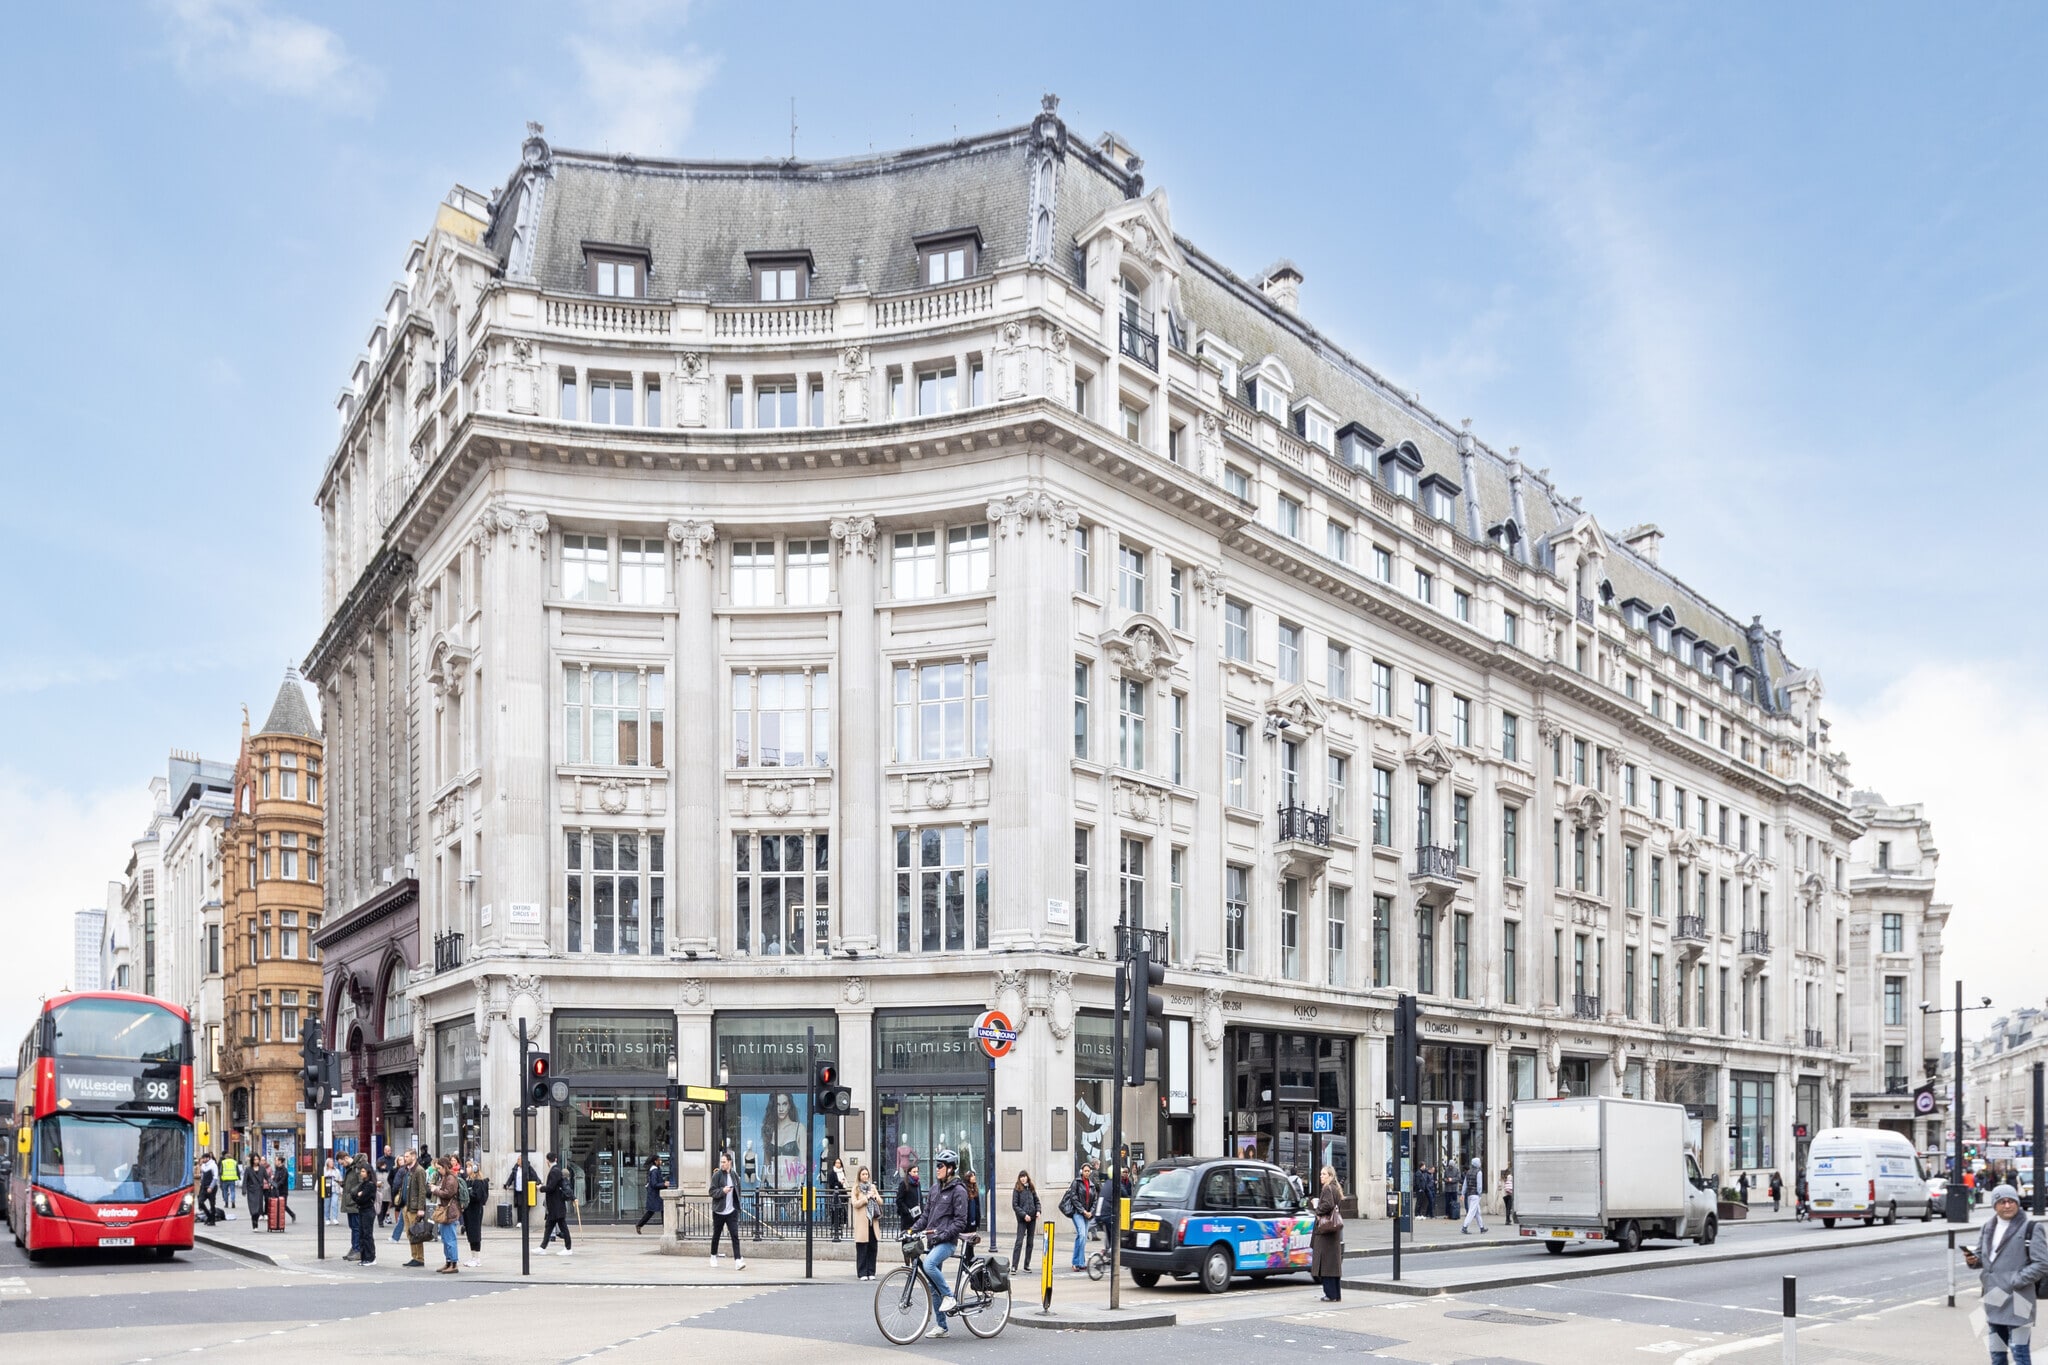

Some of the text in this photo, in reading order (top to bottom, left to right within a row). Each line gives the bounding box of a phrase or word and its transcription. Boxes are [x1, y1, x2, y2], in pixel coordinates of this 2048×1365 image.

[1222, 1000, 1242, 1011] 62-264
[1293, 1004, 1318, 1018] KIKO
[1431, 1023, 1452, 1034] OMEGA
[568, 1042, 668, 1054] intimissim
[732, 1042, 833, 1054] intimissmi
[66, 1078, 132, 1092] Willesden
[146, 1082, 169, 1100] 98
[1378, 1119, 1394, 1128] KIKO
[97, 1207, 138, 1218] Metroline
